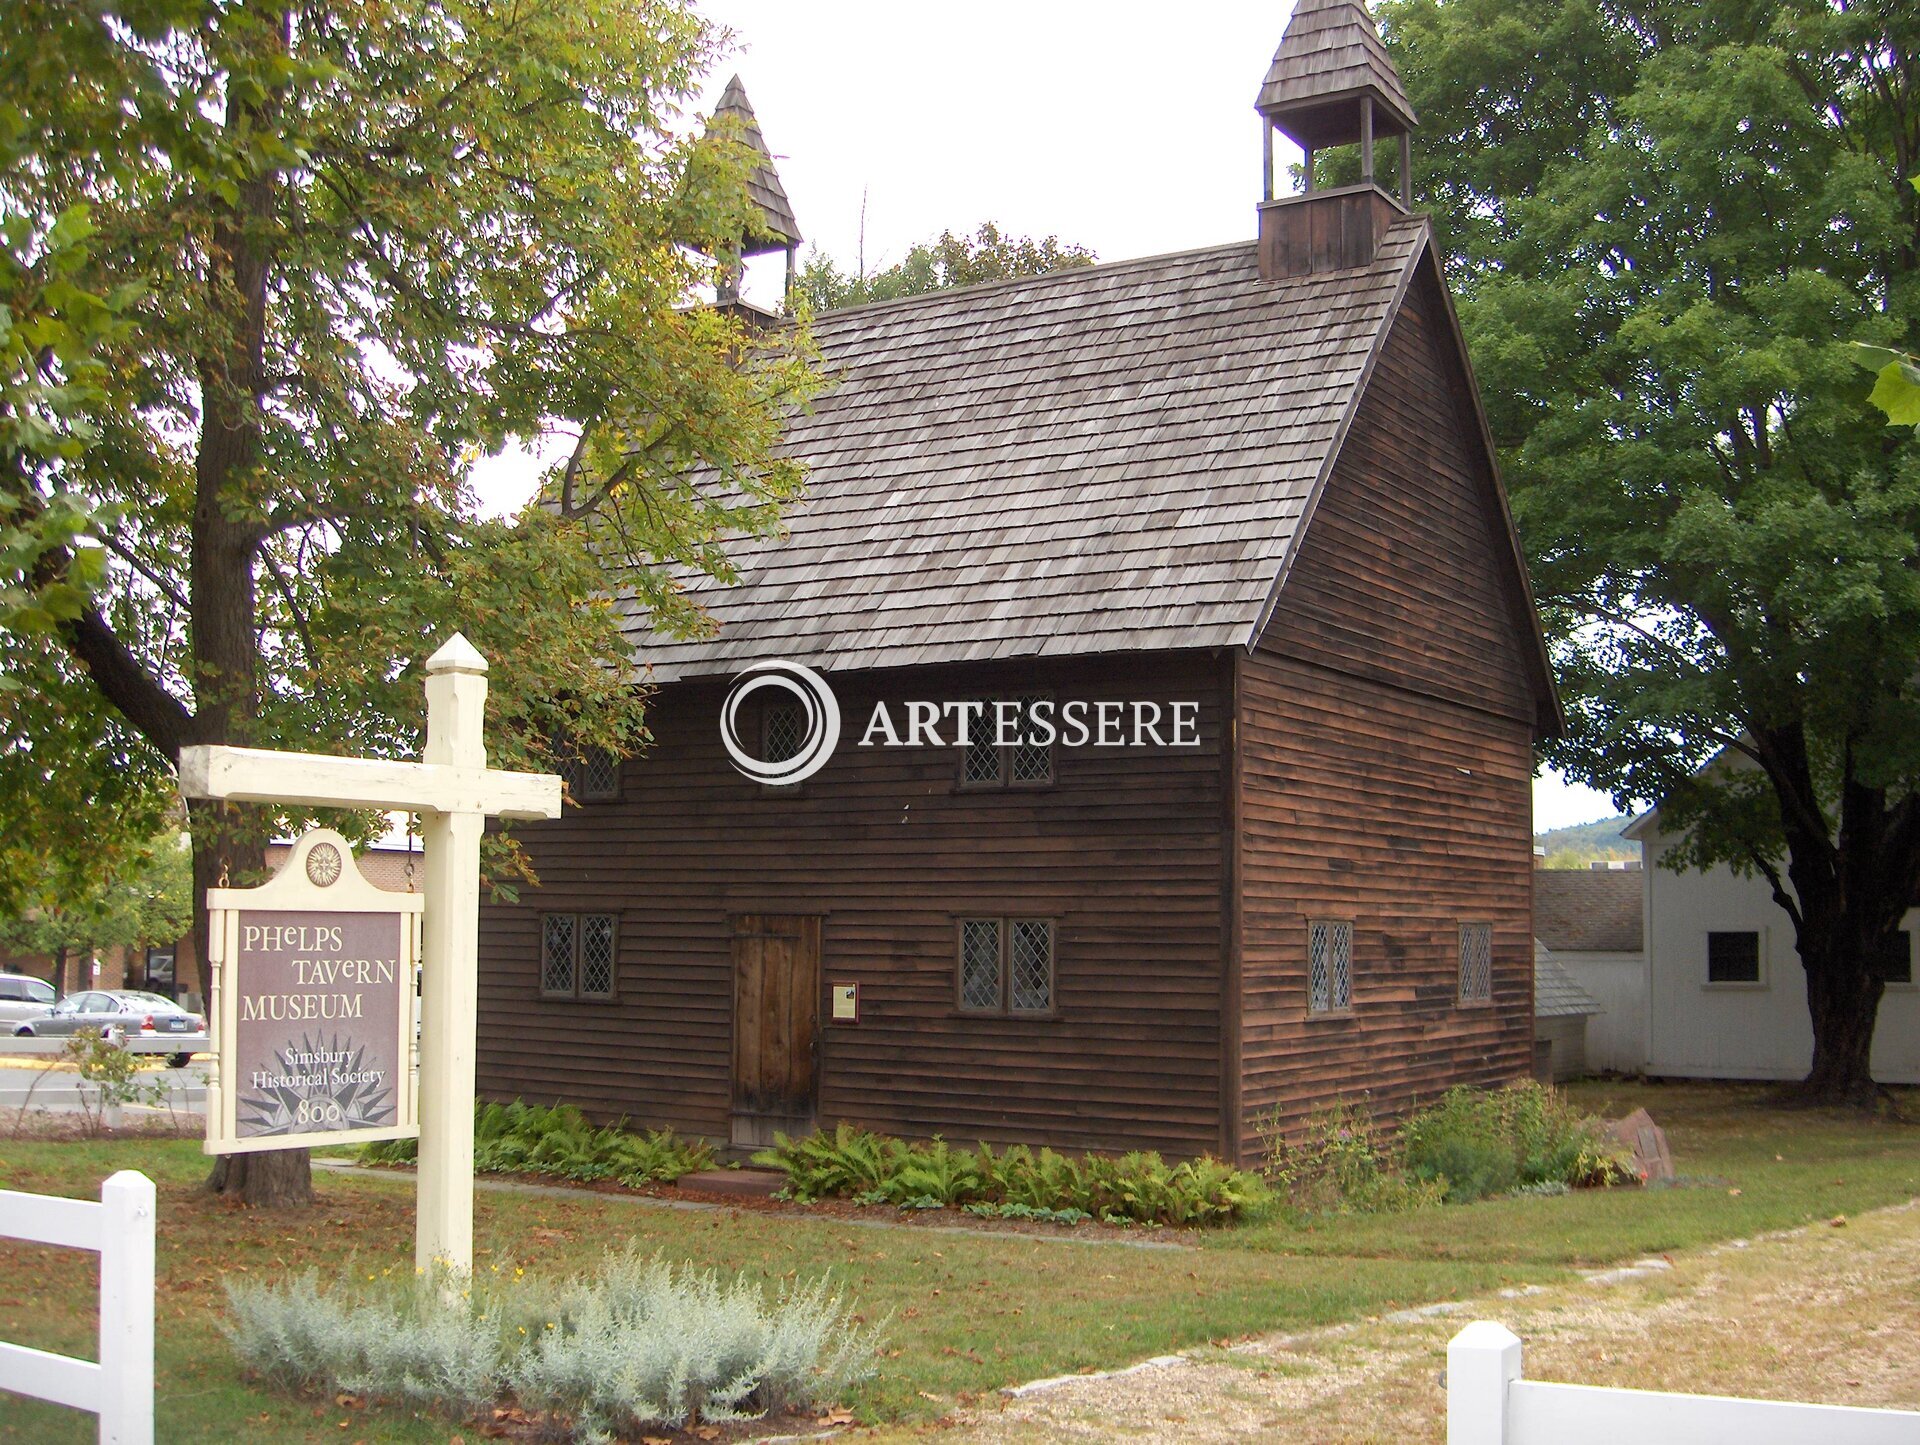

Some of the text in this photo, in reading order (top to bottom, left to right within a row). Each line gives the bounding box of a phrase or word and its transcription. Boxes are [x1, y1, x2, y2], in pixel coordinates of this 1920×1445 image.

[241, 993, 363, 1021] MUSEUM
[285, 1047, 355, 1067] Simsbury
[252, 1067, 385, 1089] Historical Society
[297, 1100, 340, 1125] 800
